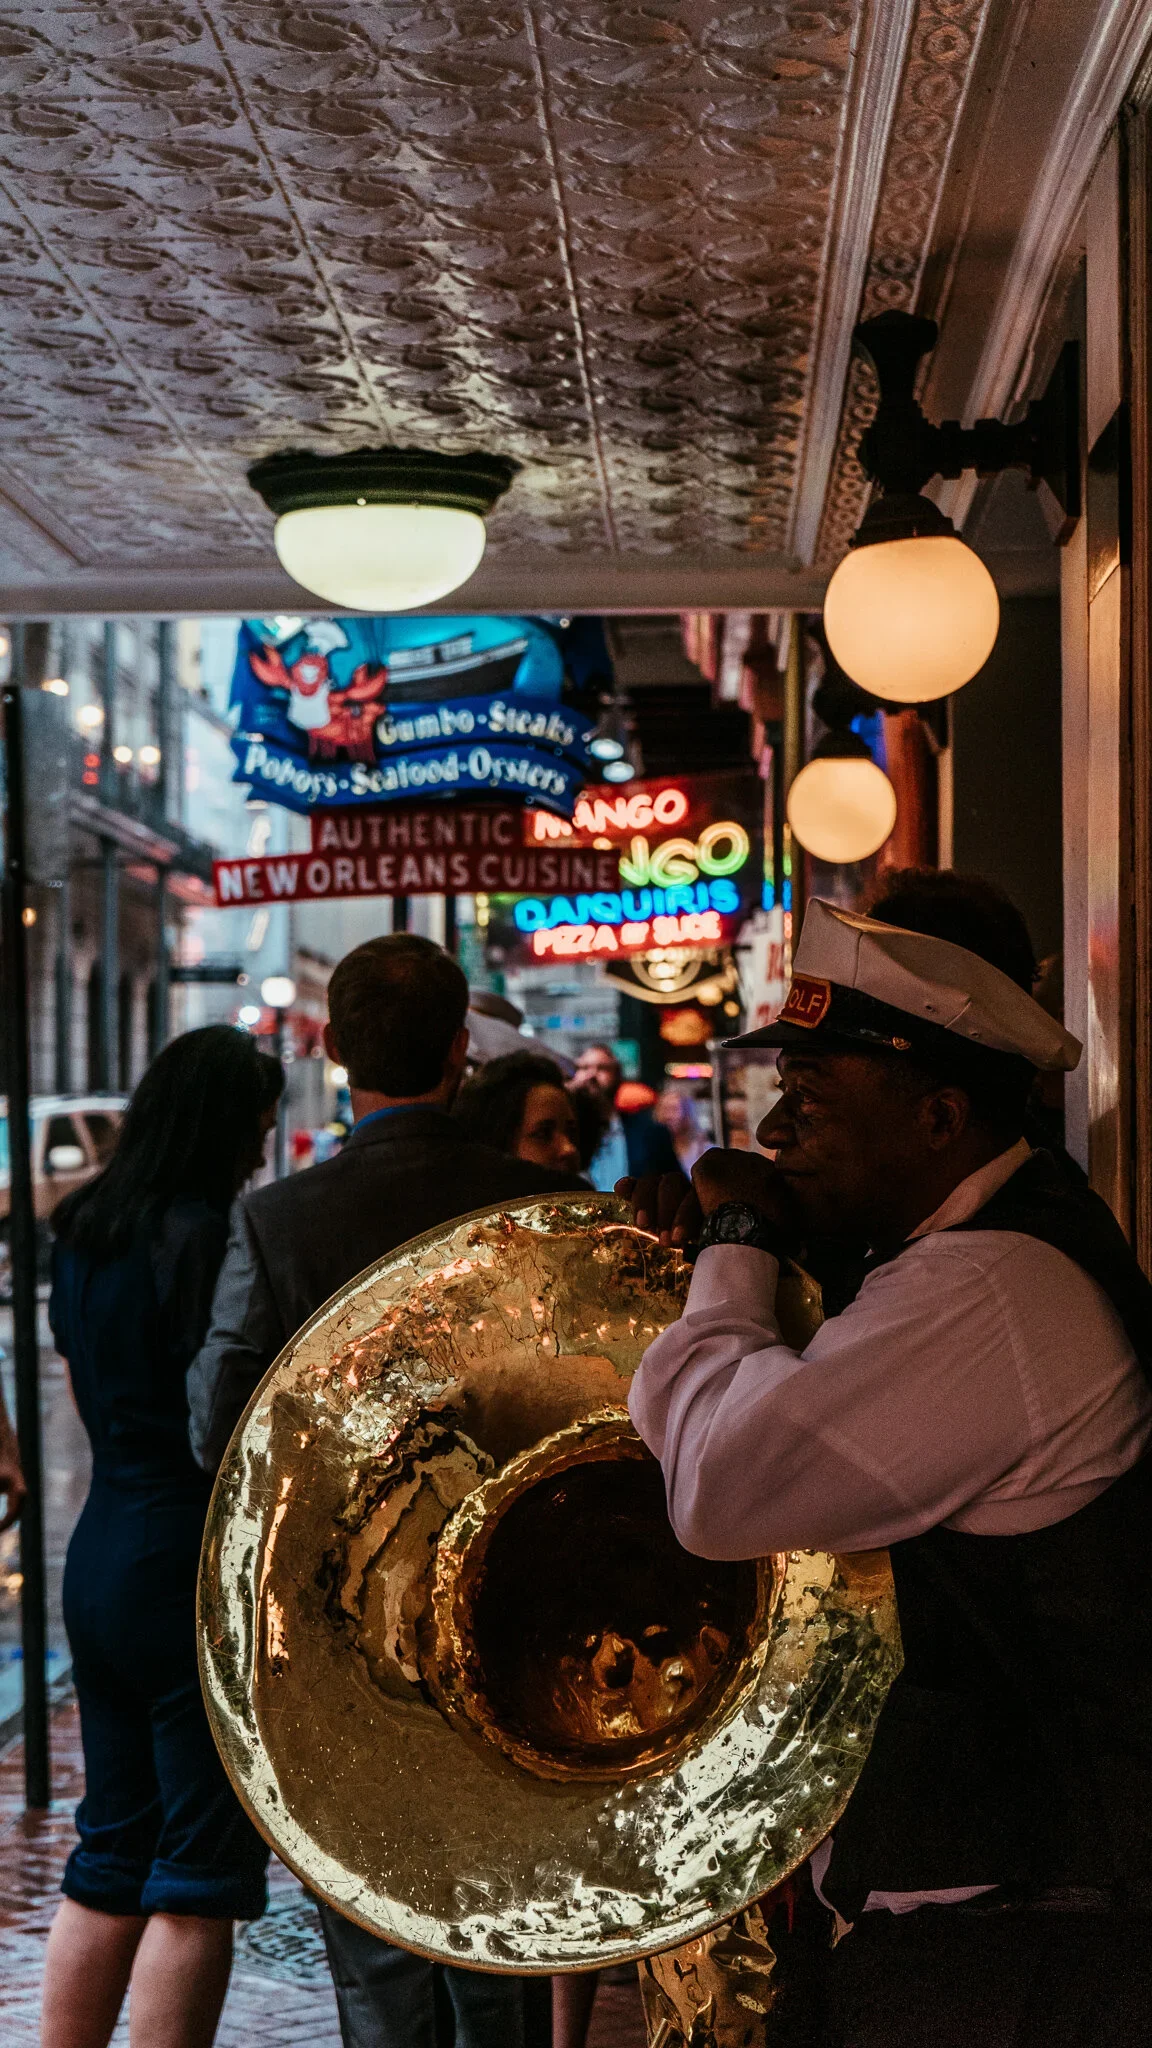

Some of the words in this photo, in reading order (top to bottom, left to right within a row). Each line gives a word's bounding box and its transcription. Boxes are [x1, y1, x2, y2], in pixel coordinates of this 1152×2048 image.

[320, 812, 514, 849] AUTHENTIC
[533, 788, 688, 840] MANGO
[217, 861, 299, 900] NEW
[306, 853, 470, 893] ORLEANS
[478, 854, 615, 888] CUISINE
[514, 879, 740, 932] DAIQUIRIS
[533, 923, 618, 955] PIZZA
[652, 911, 722, 945] SLICE
[788, 989, 823, 1014] OLF
